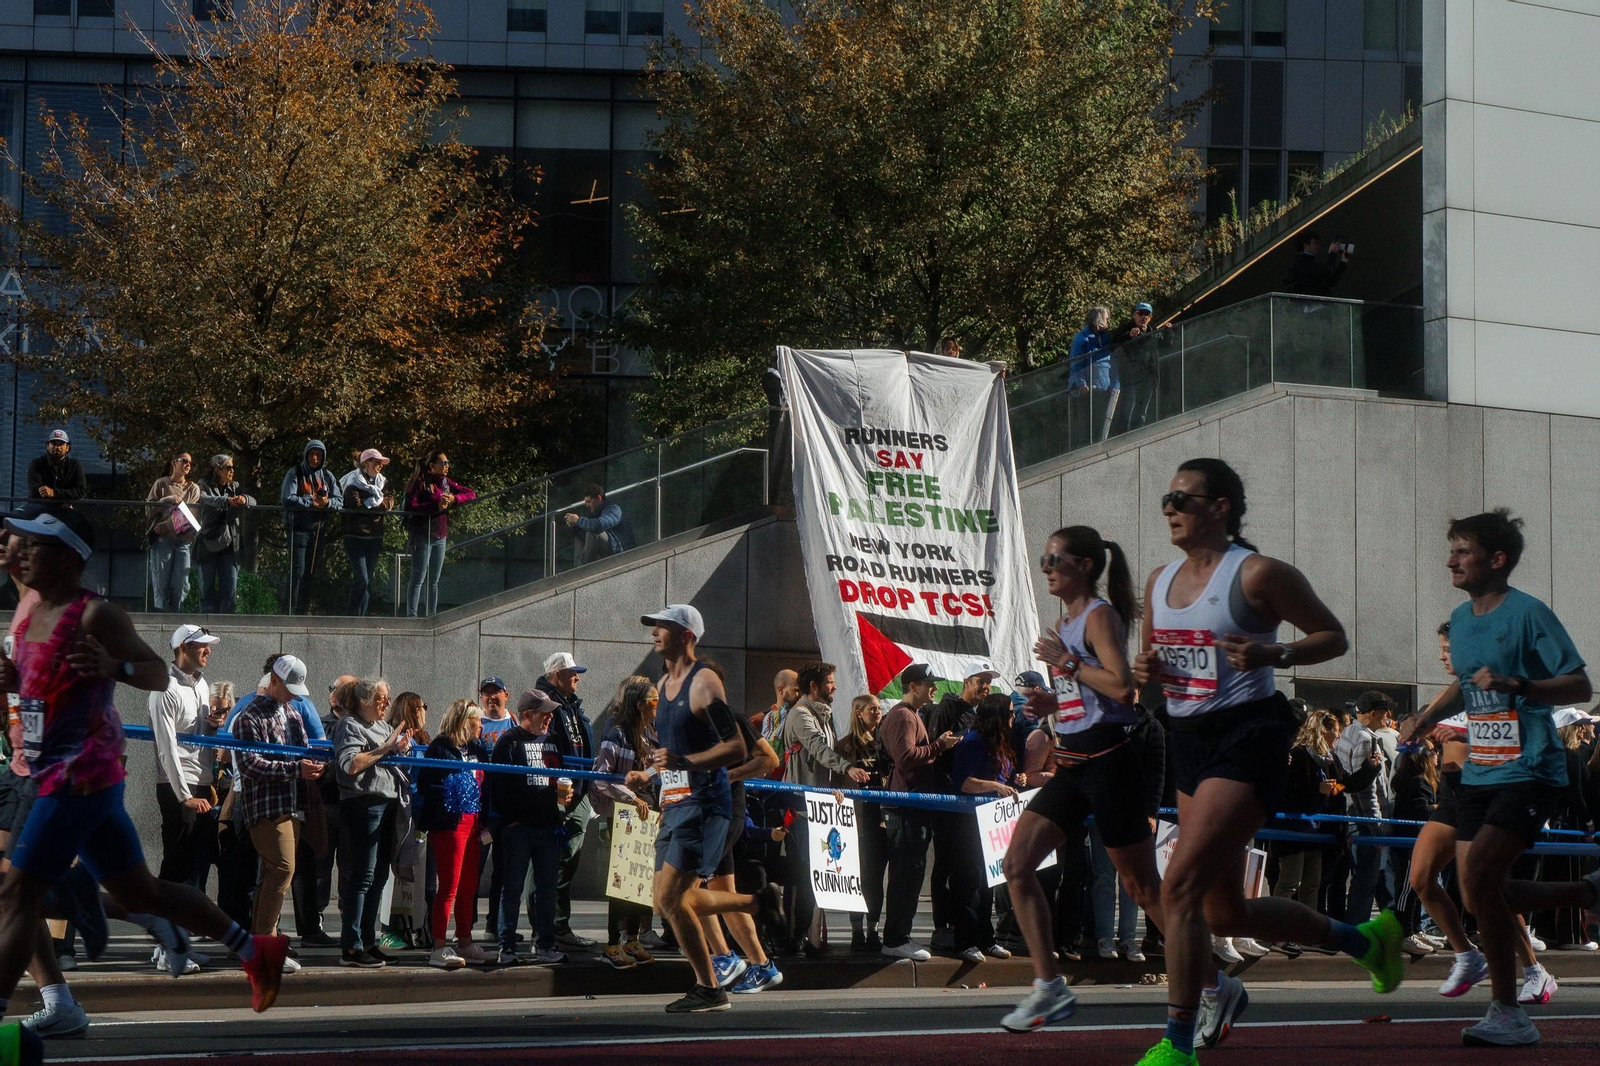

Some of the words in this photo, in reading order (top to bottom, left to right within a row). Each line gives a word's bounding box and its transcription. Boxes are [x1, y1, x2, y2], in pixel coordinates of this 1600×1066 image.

[845, 428, 949, 452] RUNNERS
[876, 449, 924, 470] SAY
[866, 471, 942, 500] FREE
[828, 491, 1000, 534] PALESTINE
[849, 533, 891, 556] NEW
[895, 542, 957, 563] YORK
[826, 554, 886, 579] ROAD
[889, 566, 996, 587] RUNNERS
[838, 579, 915, 611] DROP
[919, 591, 996, 618] TCS!
[1158, 646, 1209, 670] 19510
[1470, 689, 1501, 708] JACK
[525, 751, 543, 760] NEW
[526, 776, 550, 787] CREW
[807, 799, 834, 826] JUST
[834, 803, 855, 828] KEEP
[812, 869, 862, 896] RUNNING!
